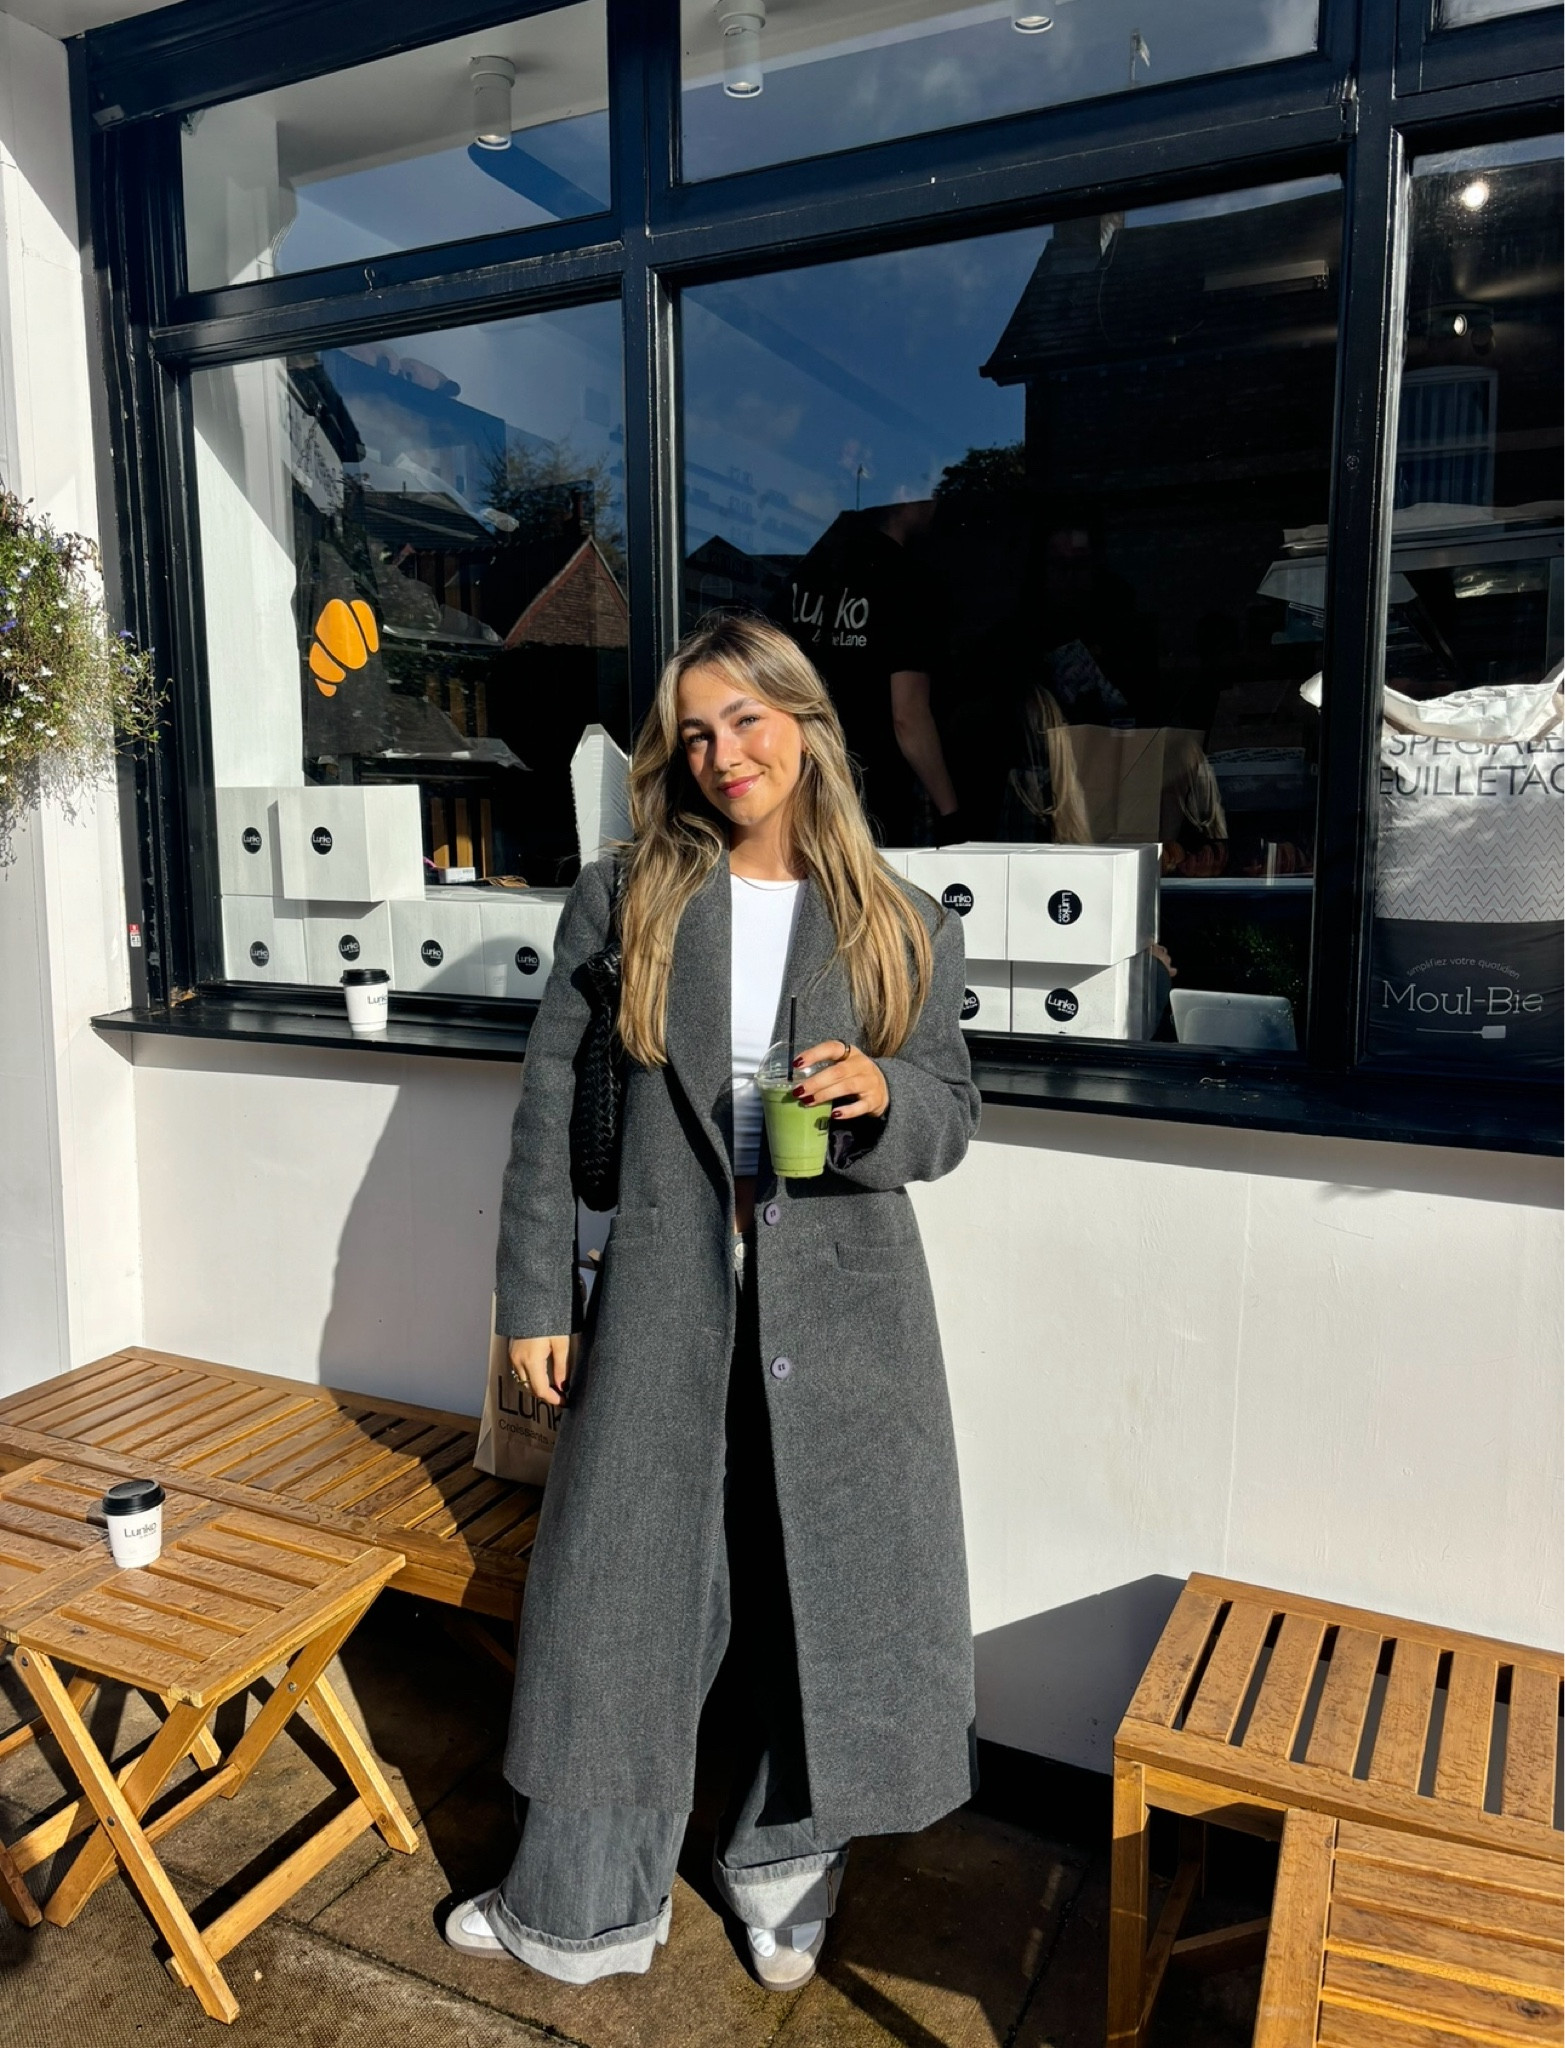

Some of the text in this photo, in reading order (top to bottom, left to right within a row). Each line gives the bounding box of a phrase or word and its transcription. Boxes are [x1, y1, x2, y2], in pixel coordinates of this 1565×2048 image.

[944, 894, 972, 903] Lunko
[1061, 892, 1072, 923] Lunko
[1450, 957, 1476, 966] votre
[1047, 994, 1077, 1011] Lunko
[1382, 980, 1544, 1015] Moul-Bie
[124, 1522, 156, 1538] Lunko
